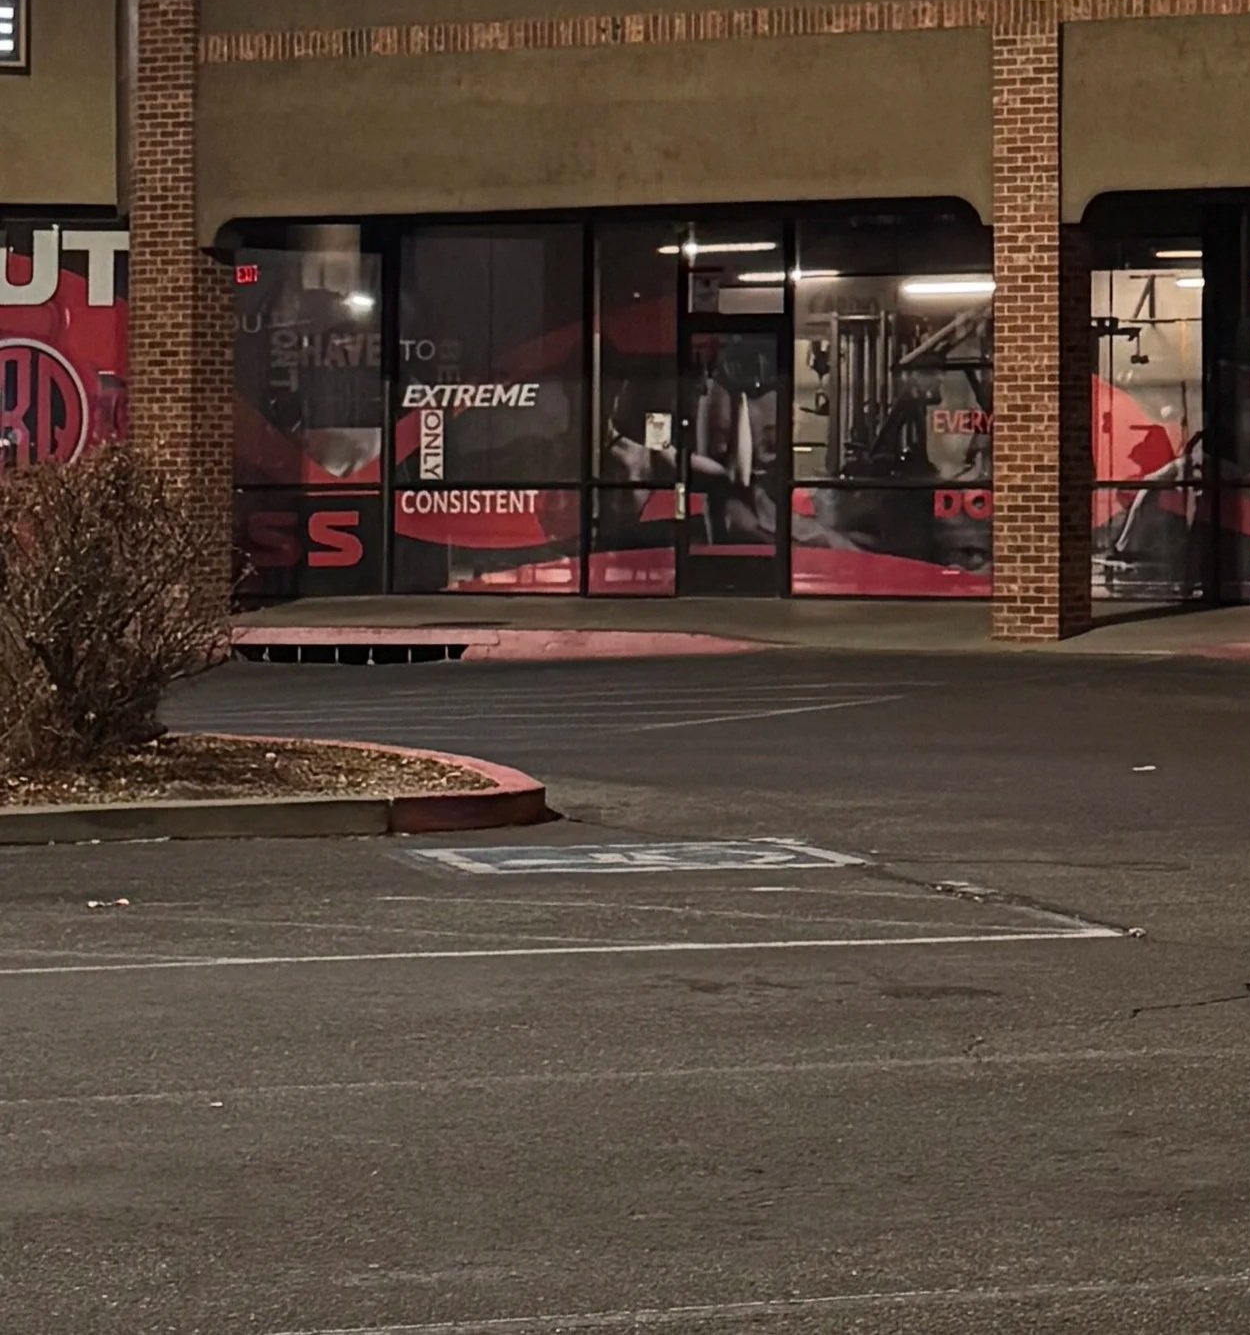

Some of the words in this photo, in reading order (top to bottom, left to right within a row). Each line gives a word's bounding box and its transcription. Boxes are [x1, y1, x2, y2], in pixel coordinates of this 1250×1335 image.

[400, 339, 435, 361] TO
[402, 383, 540, 408] EXTREME
[423, 412, 443, 480] ONLY
[401, 490, 539, 514] CONSISTENT
